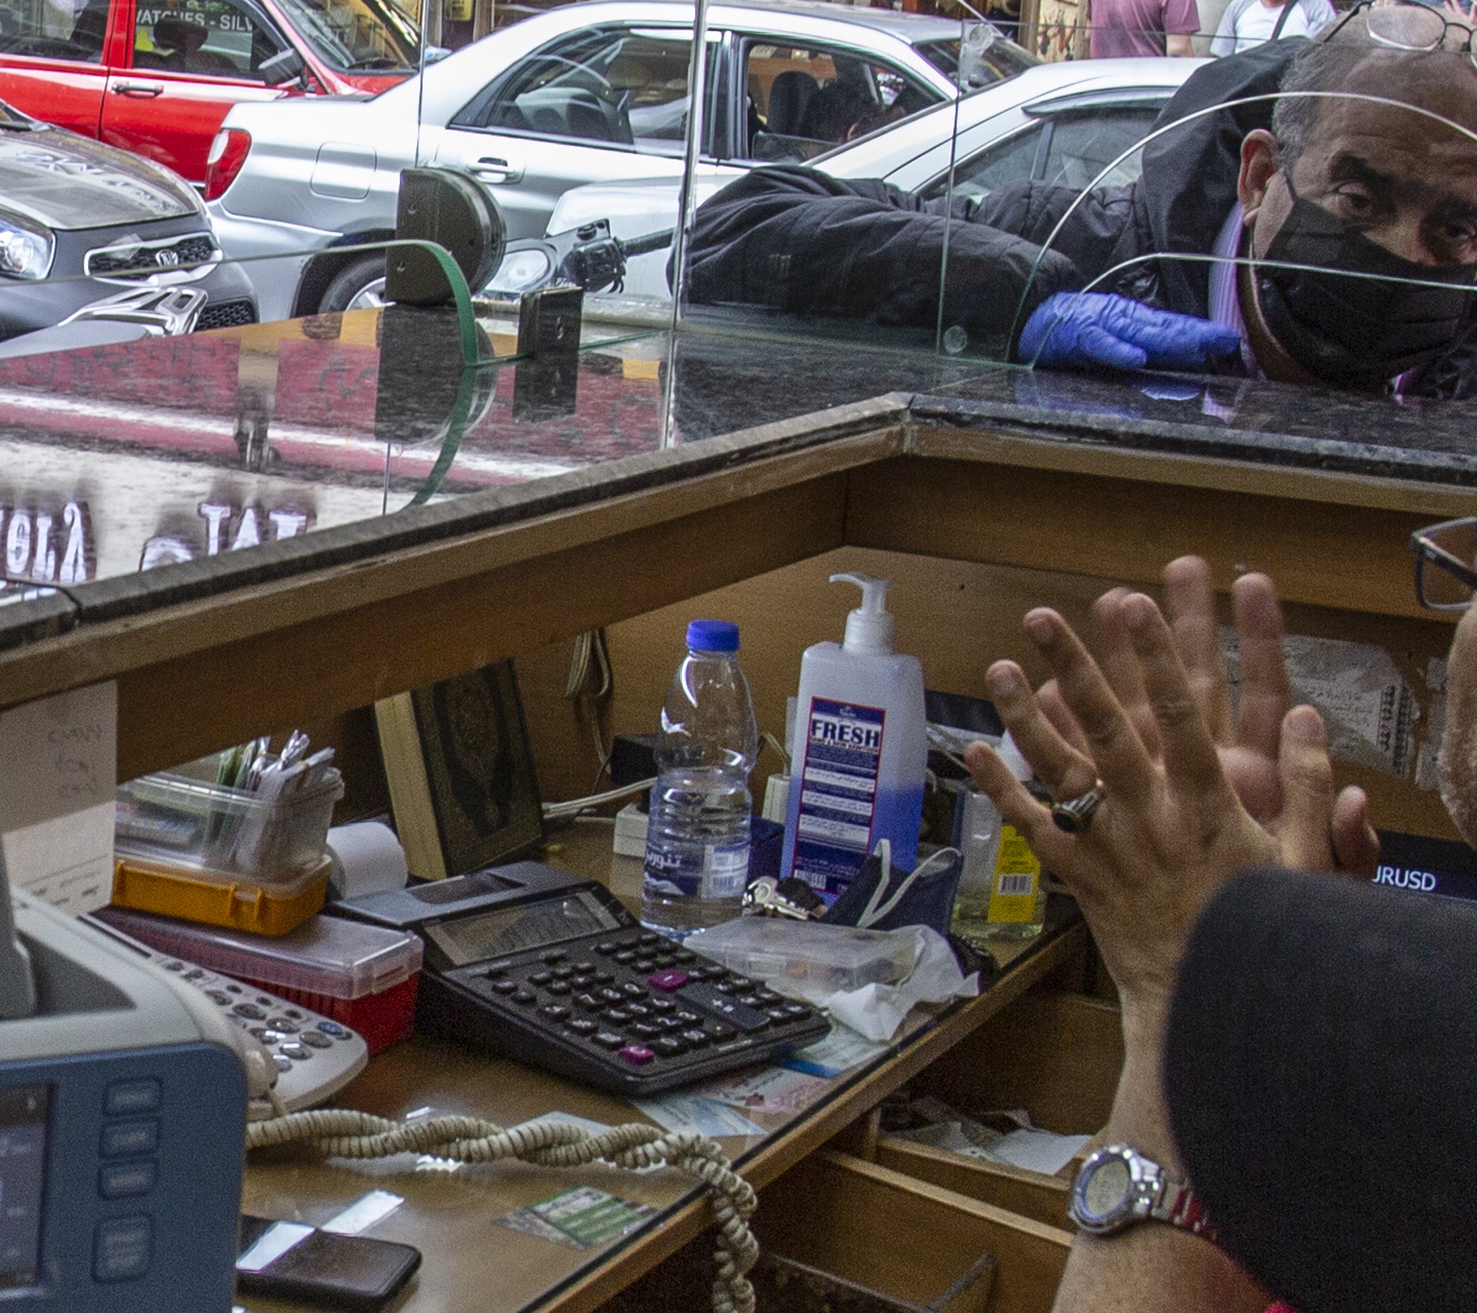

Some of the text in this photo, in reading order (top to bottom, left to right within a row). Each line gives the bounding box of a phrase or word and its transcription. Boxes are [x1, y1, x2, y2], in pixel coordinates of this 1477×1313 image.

[219, 14, 254, 32] SILV
[811, 719, 880, 749] FRESH
[1372, 864, 1437, 891] RUSD
